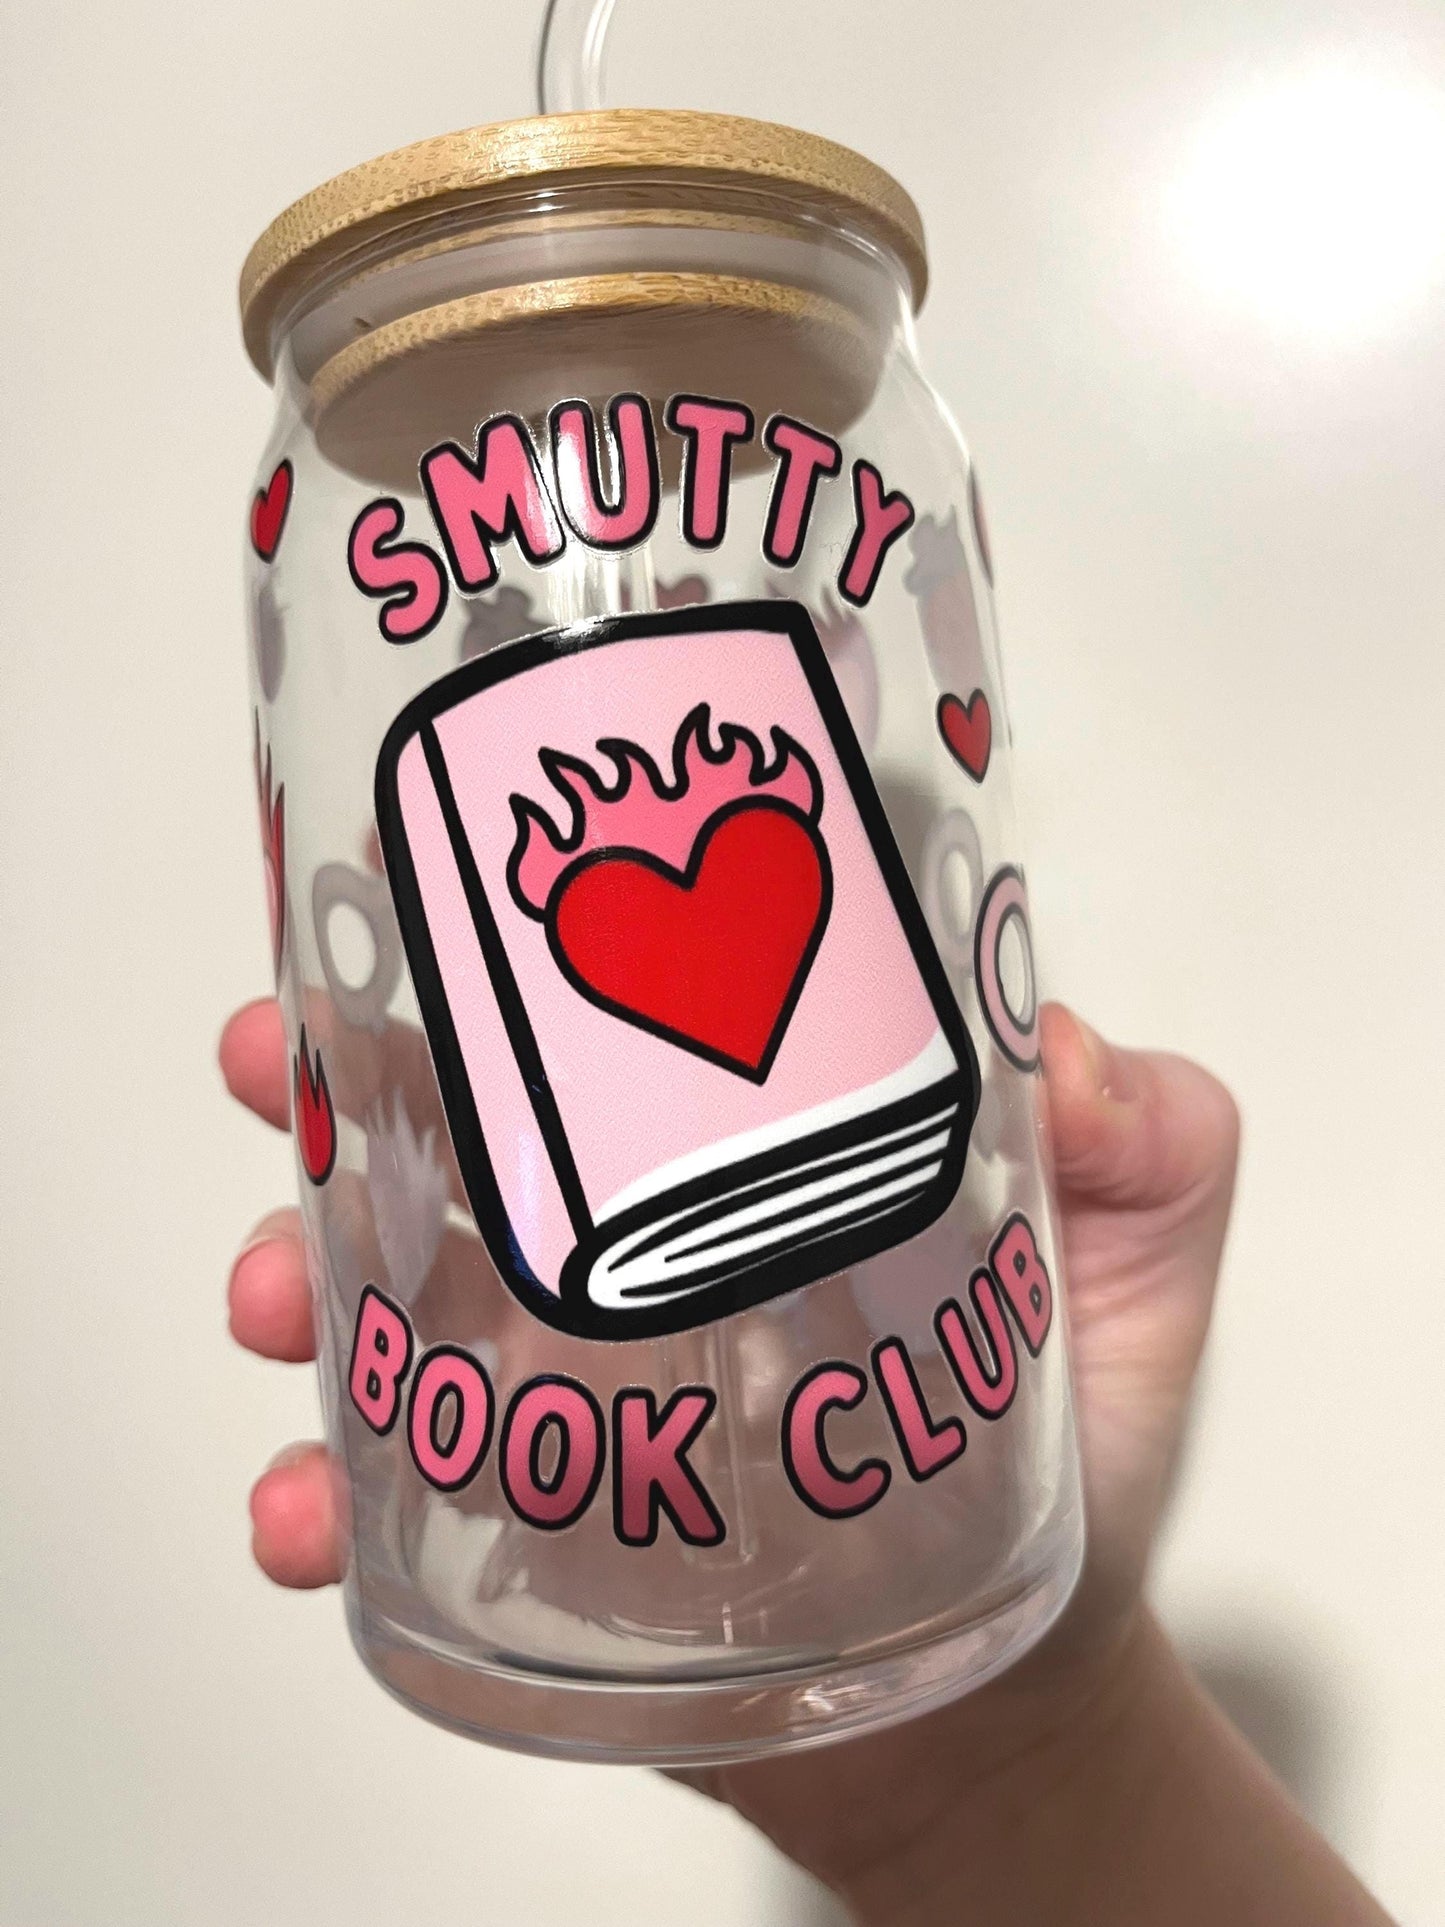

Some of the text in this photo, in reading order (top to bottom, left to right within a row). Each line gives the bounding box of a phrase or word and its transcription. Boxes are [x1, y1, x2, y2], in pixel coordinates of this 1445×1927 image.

[347, 393, 914, 643] SMUTTY
[349, 1212, 1053, 1547] BOOK CLUB
